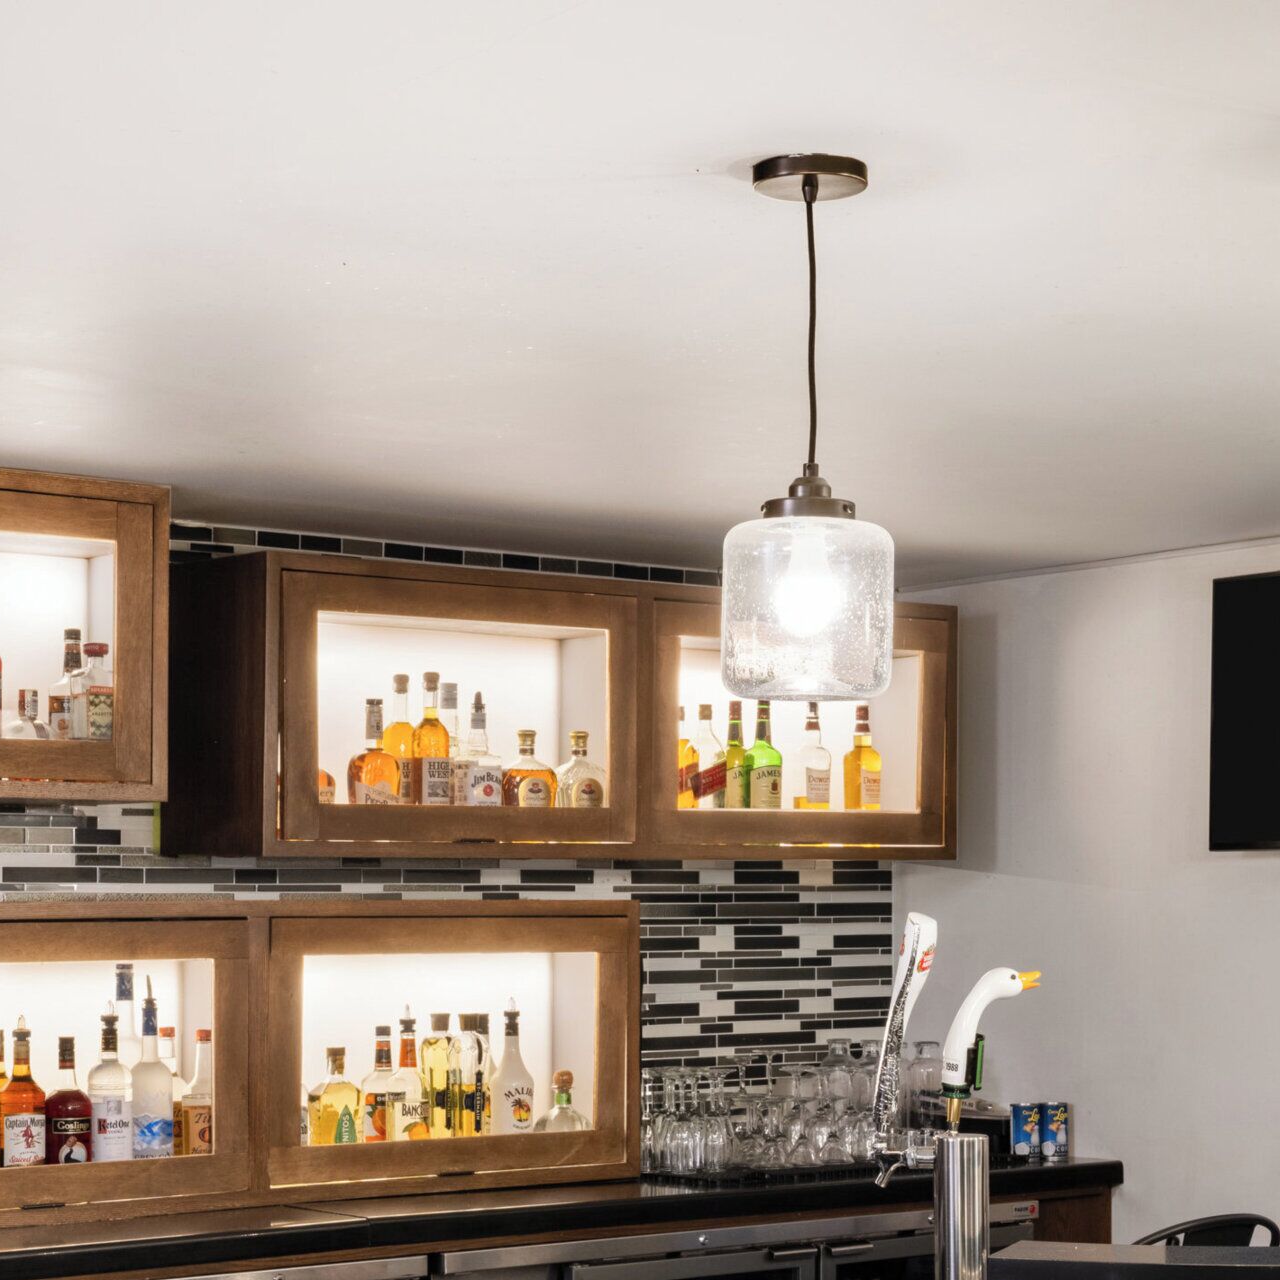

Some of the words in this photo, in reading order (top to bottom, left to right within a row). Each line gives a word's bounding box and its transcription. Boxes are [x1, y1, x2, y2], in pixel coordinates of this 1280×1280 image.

[756, 769, 781, 780] JAMES
[945, 1062, 959, 1072] 1988
[504, 1086, 534, 1101] MALIB
[30, 1117, 45, 1128] Morga
[341, 1114, 350, 1142] NITOS
